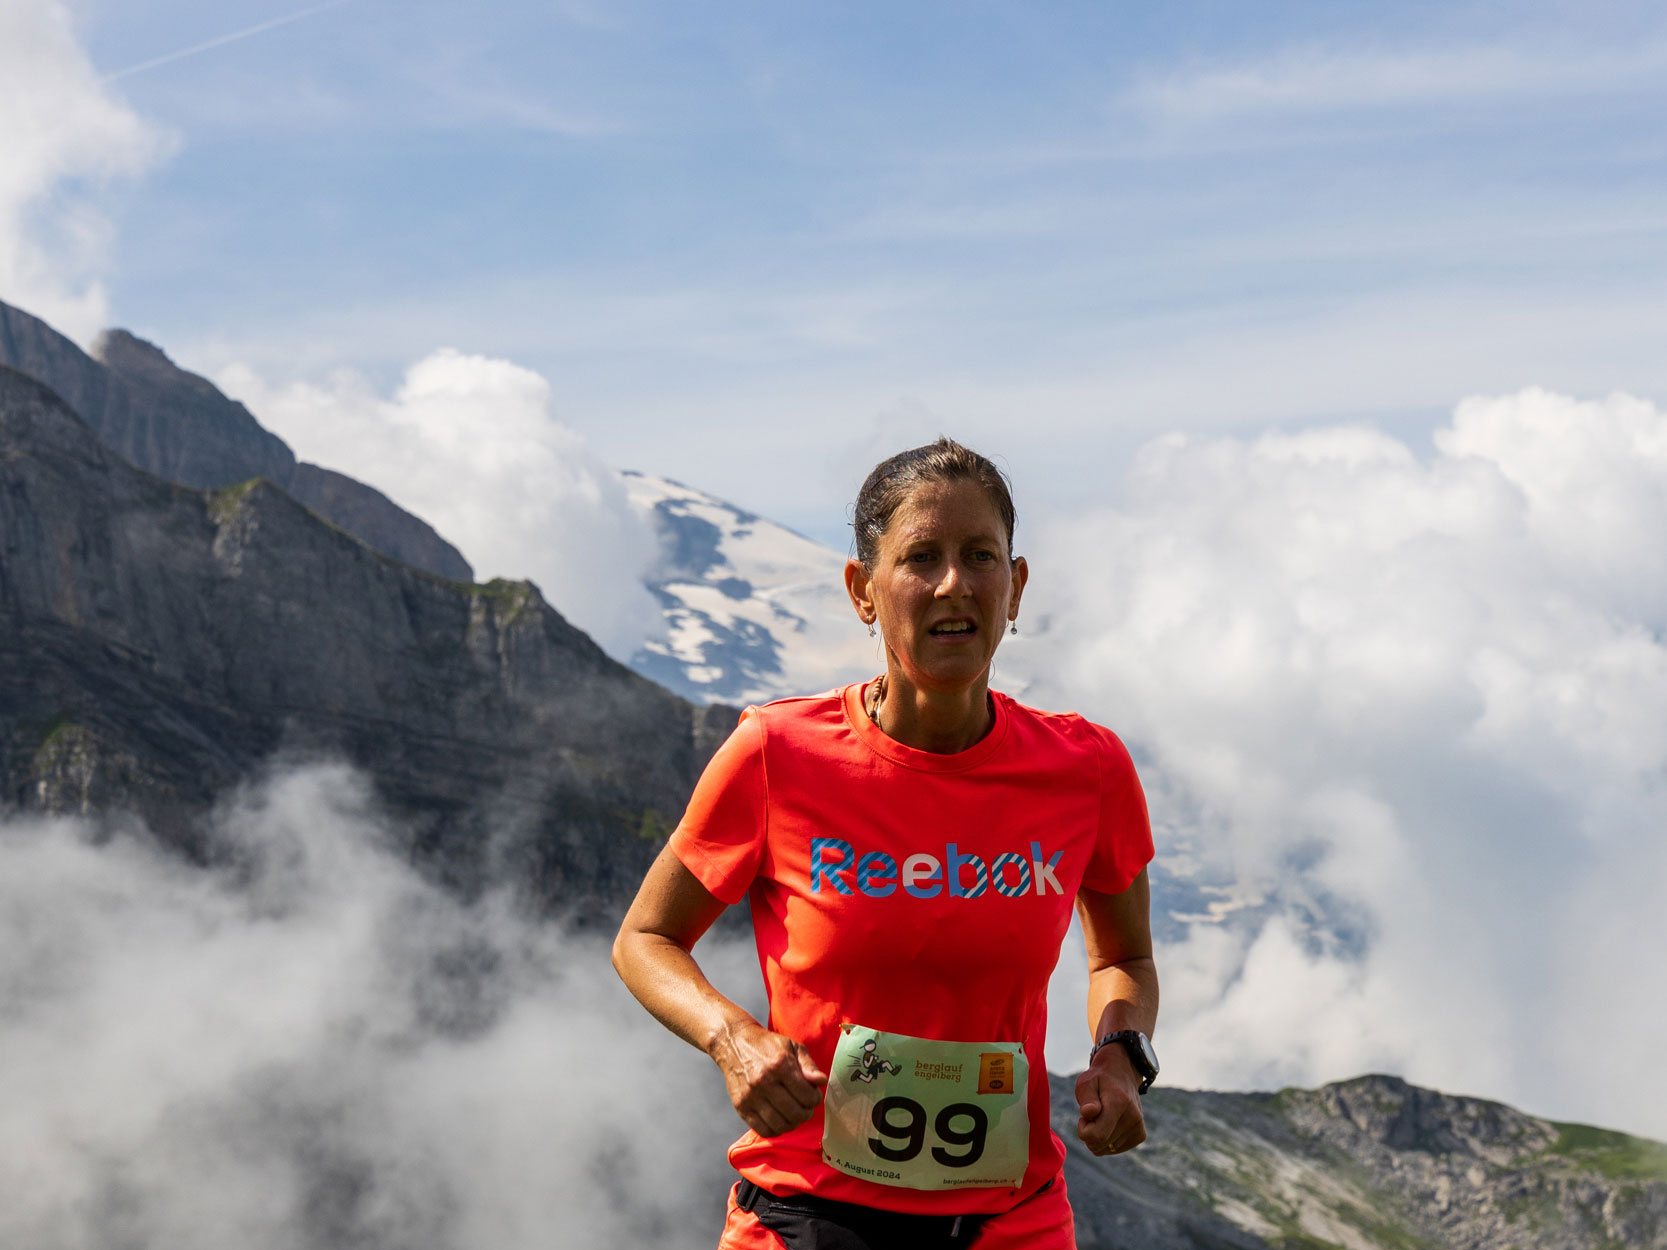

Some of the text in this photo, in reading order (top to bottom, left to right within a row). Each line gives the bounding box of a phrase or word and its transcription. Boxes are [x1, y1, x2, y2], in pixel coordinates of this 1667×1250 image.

[811, 837, 1065, 898] Reebok
[914, 1069, 962, 1083] engelberg
[915, 1060, 963, 1073] berglauf
[868, 1096, 989, 1168] 99
[844, 1161, 875, 1175] August
[877, 1169, 901, 1180] 2024
